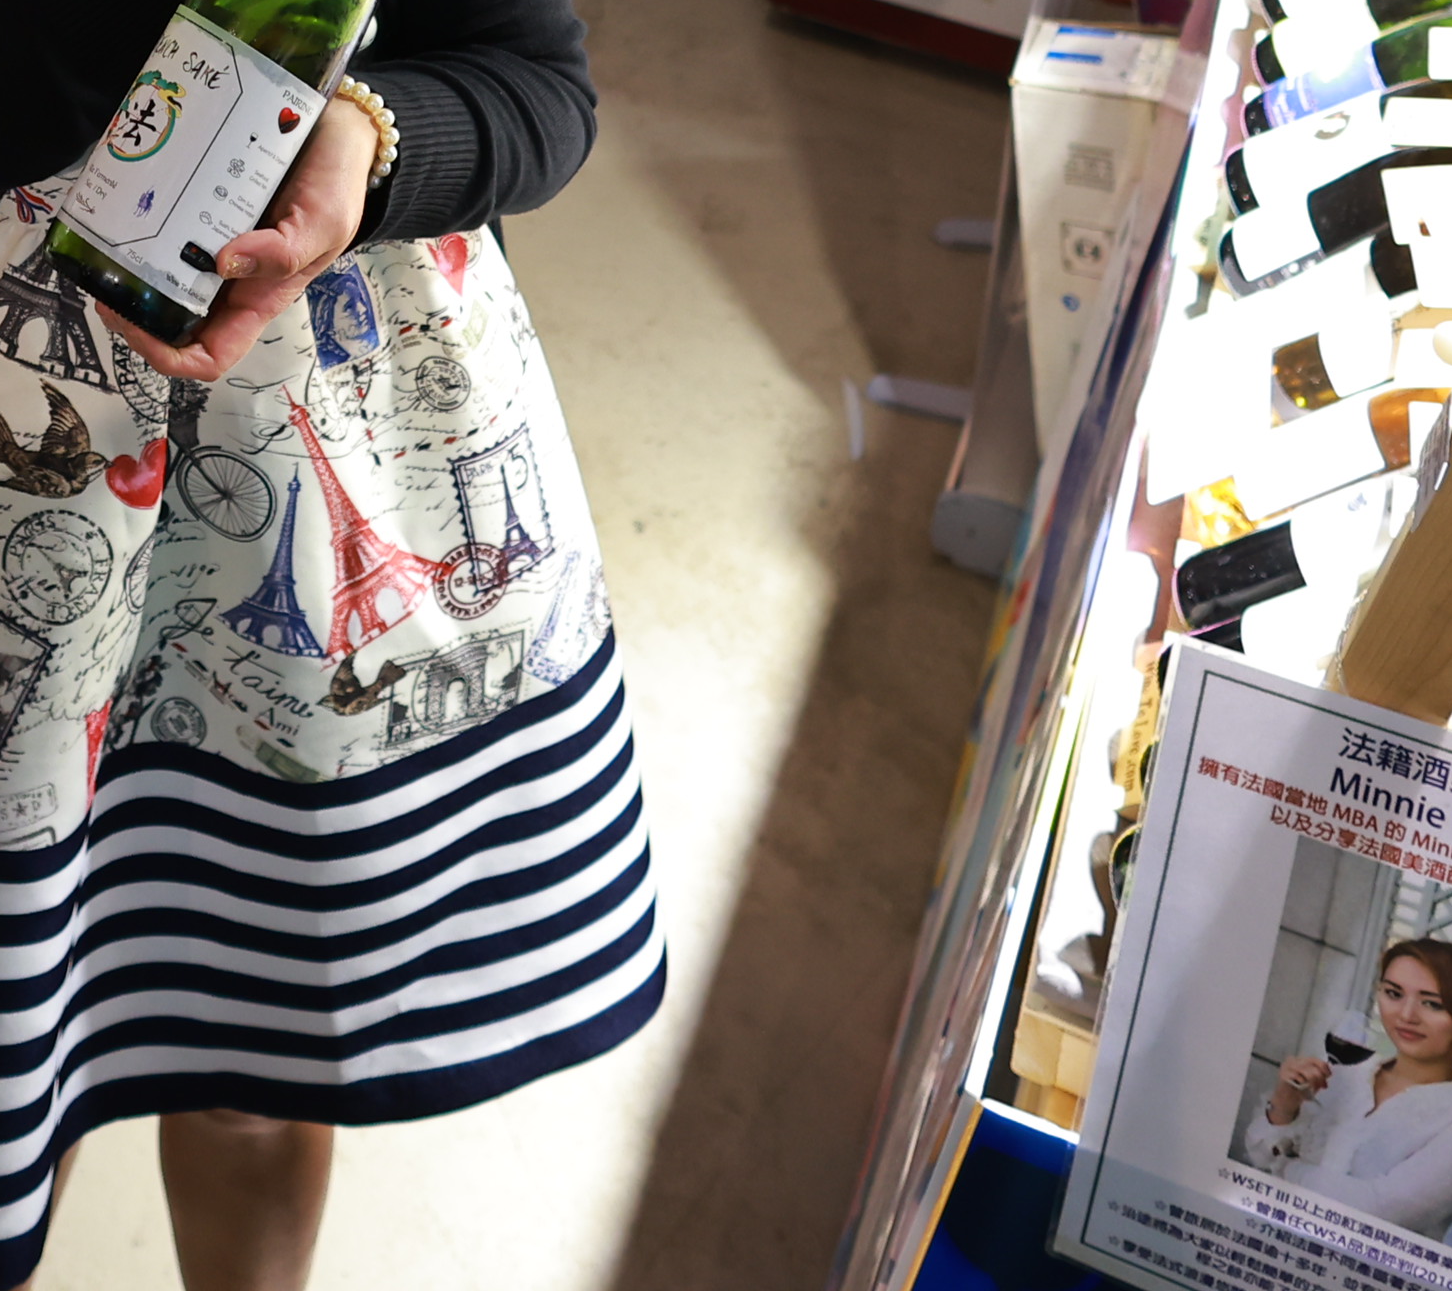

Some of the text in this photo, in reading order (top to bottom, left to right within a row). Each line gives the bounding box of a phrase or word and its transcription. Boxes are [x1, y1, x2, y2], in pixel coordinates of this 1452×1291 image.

[183, 51, 230, 90] SAKÉ
[282, 89, 314, 116] PAIRING
[126, 248, 144, 265] 75cl
[1197, 755, 1328, 816] 擁有法國當地
[1331, 802, 1380, 834] MBA
[1384, 819, 1407, 843] 的
[1330, 767, 1446, 830] Minnie
[1230, 1170, 1273, 1198] WSET
